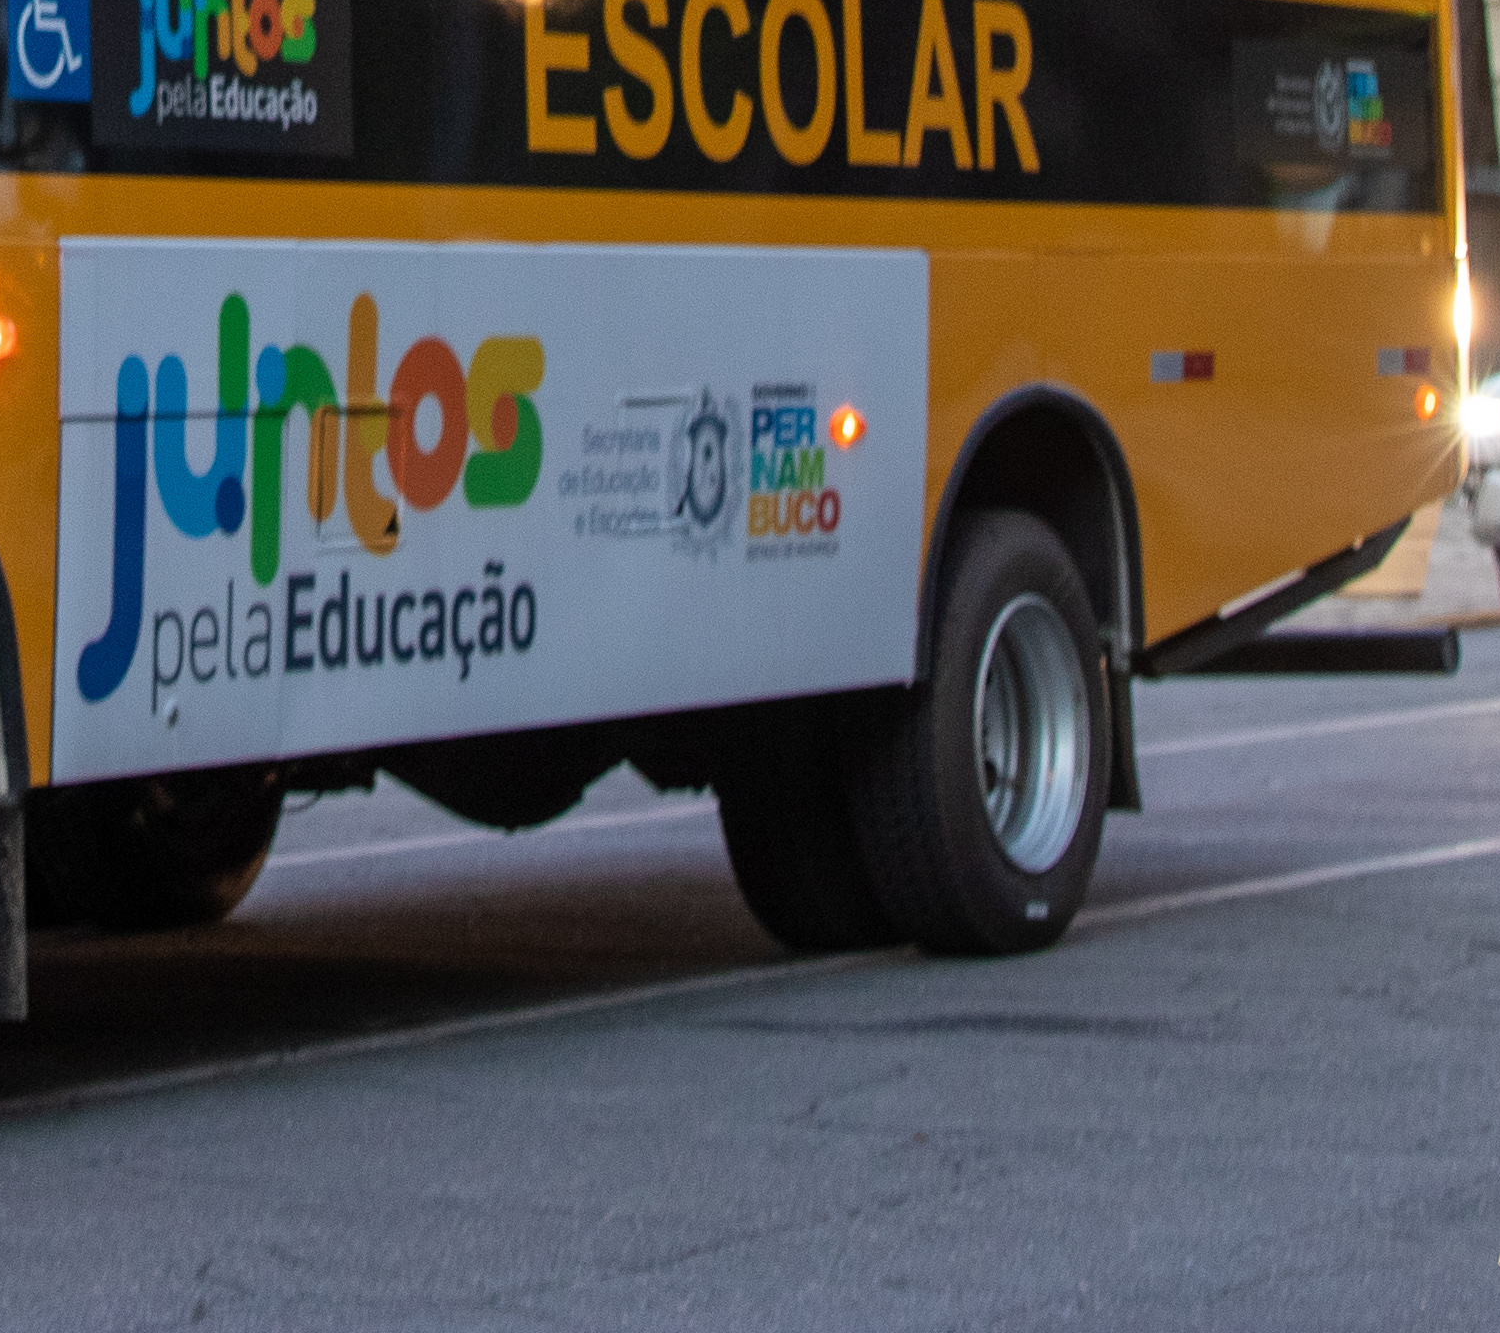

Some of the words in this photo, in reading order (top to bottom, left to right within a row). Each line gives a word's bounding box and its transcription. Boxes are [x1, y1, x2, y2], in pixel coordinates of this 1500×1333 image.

[156, 76, 208, 125] pela
[210, 73, 318, 131] Educação
[751, 407, 816, 448] PER
[77, 291, 546, 702] juntos
[750, 447, 826, 492] NAM
[747, 485, 842, 537] BUCO
[151, 579, 273, 716] pela
[283, 560, 537, 681] Educação
